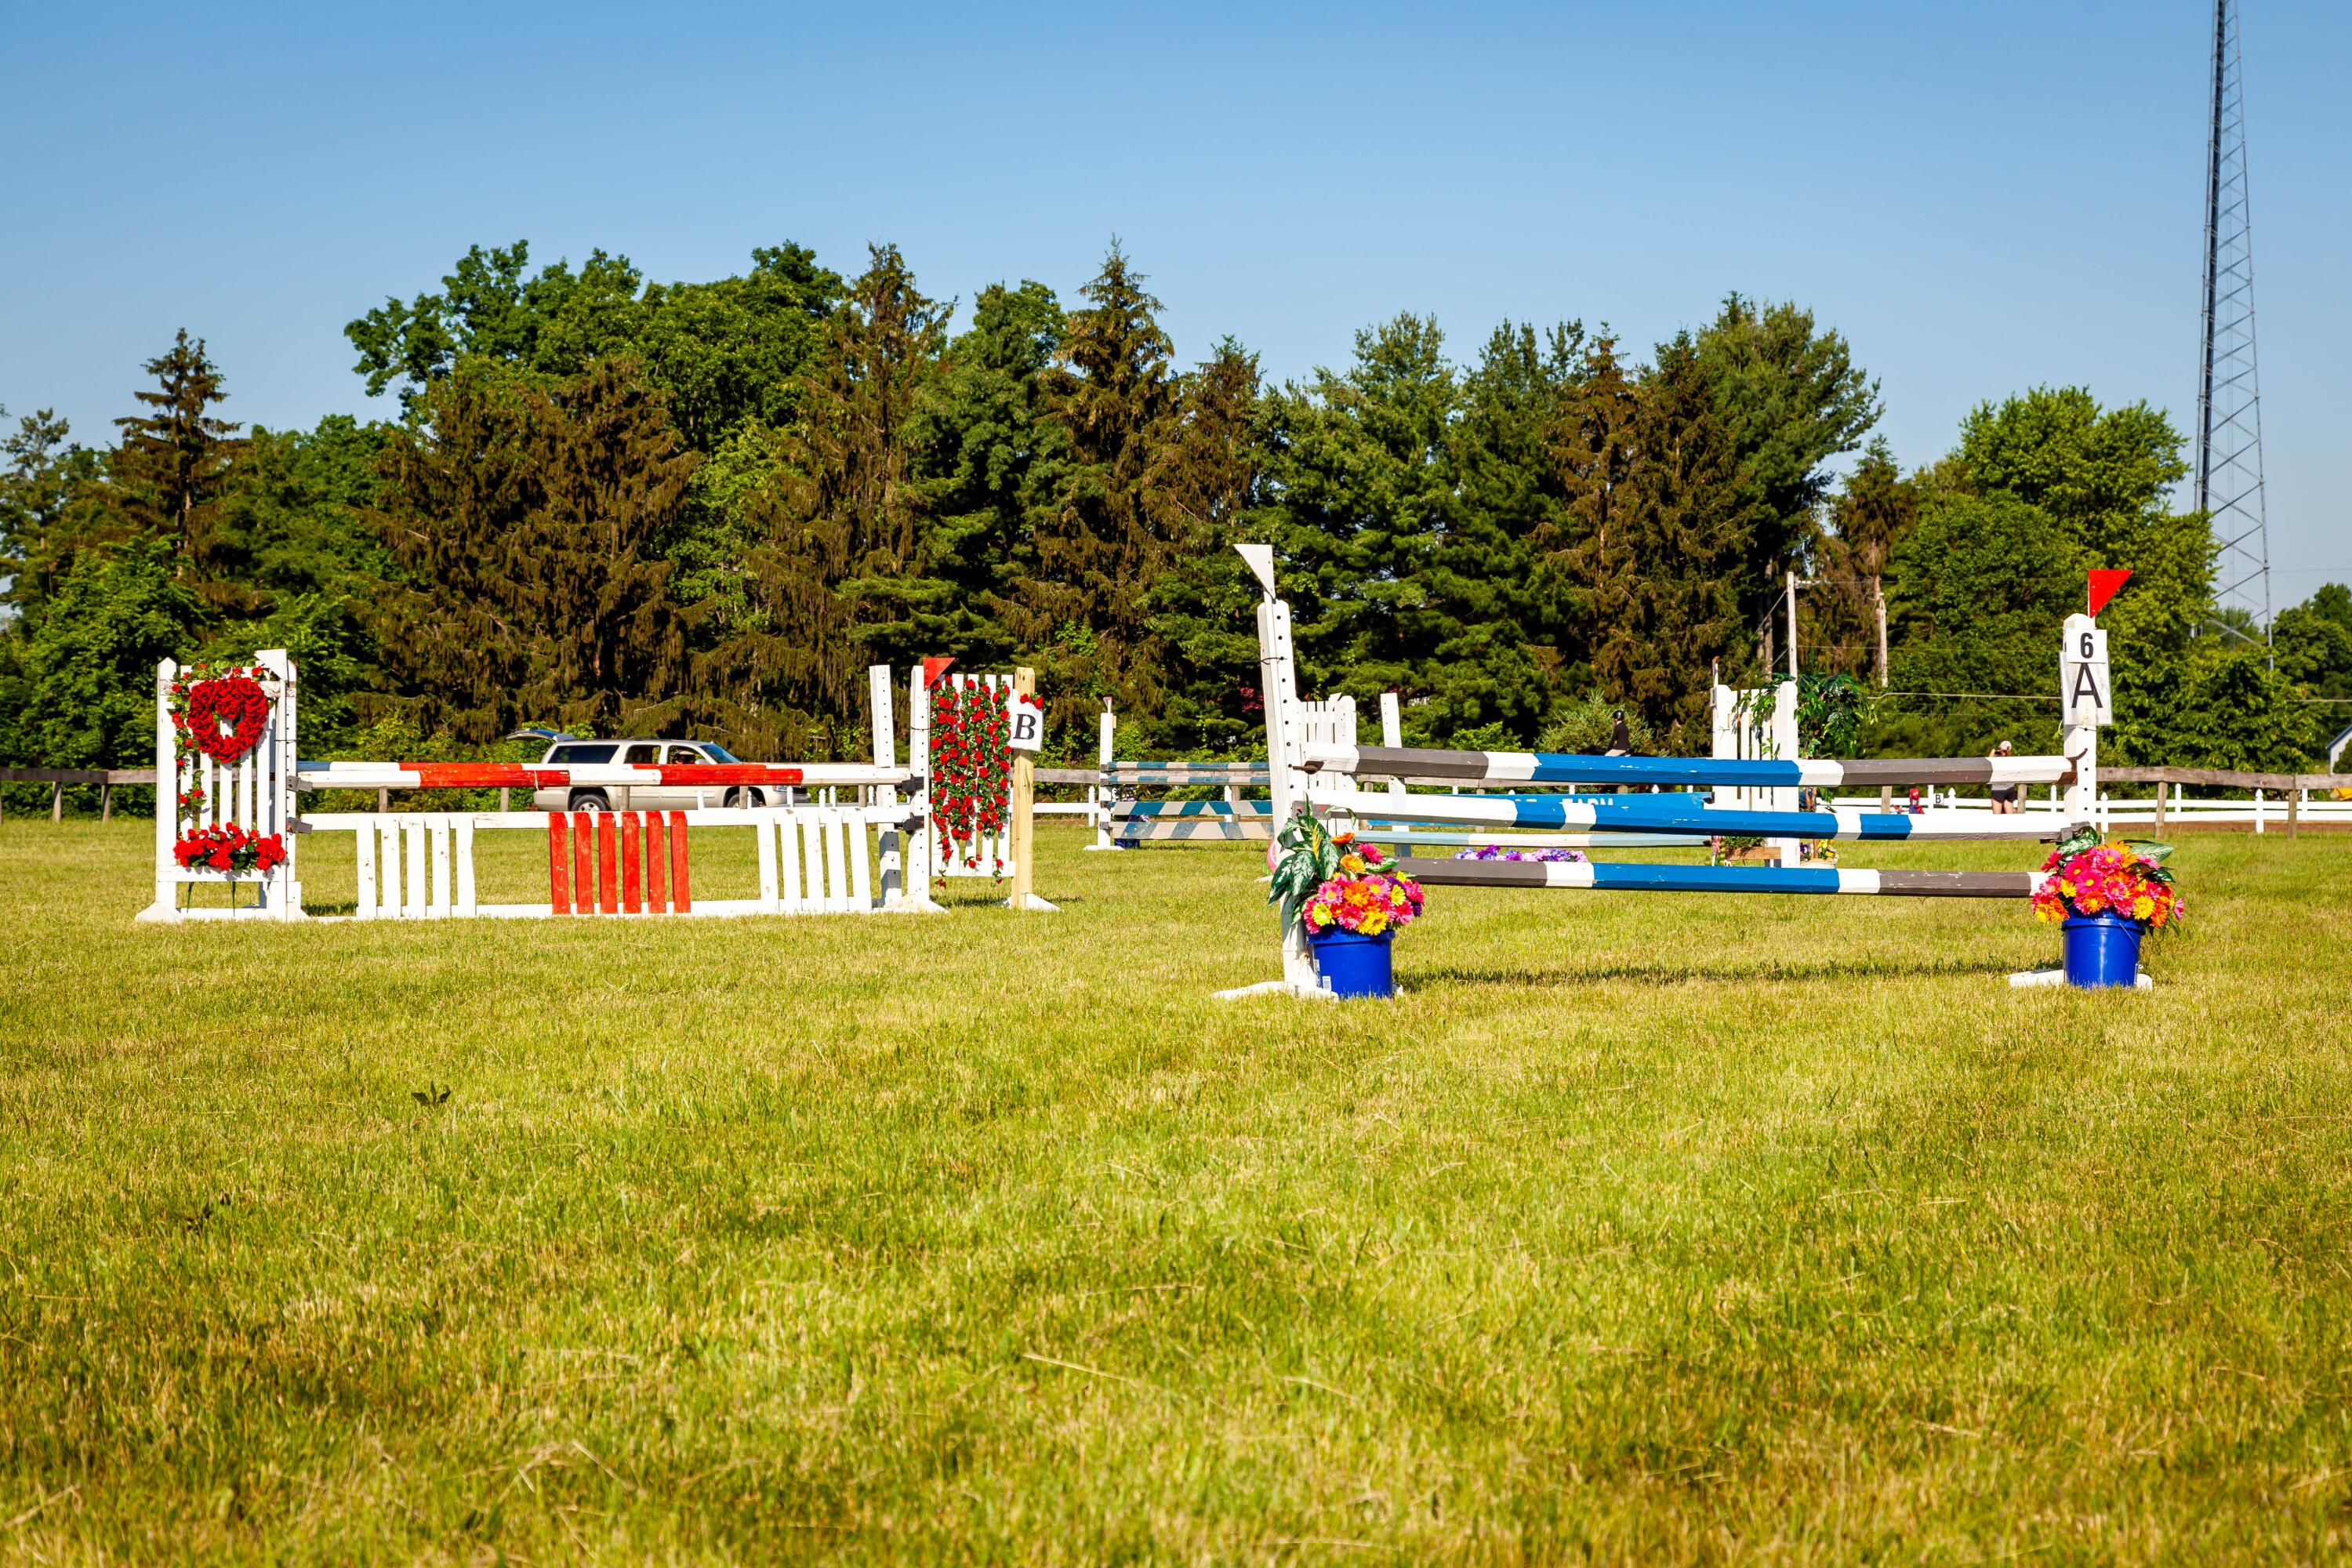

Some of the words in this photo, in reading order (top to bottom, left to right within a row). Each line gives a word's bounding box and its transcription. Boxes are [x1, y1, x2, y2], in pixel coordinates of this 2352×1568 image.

[2080, 632, 2094, 659] 6
[2071, 662, 2103, 709] A
[1012, 713, 1036, 740] B
[1935, 794, 1941, 804] B
